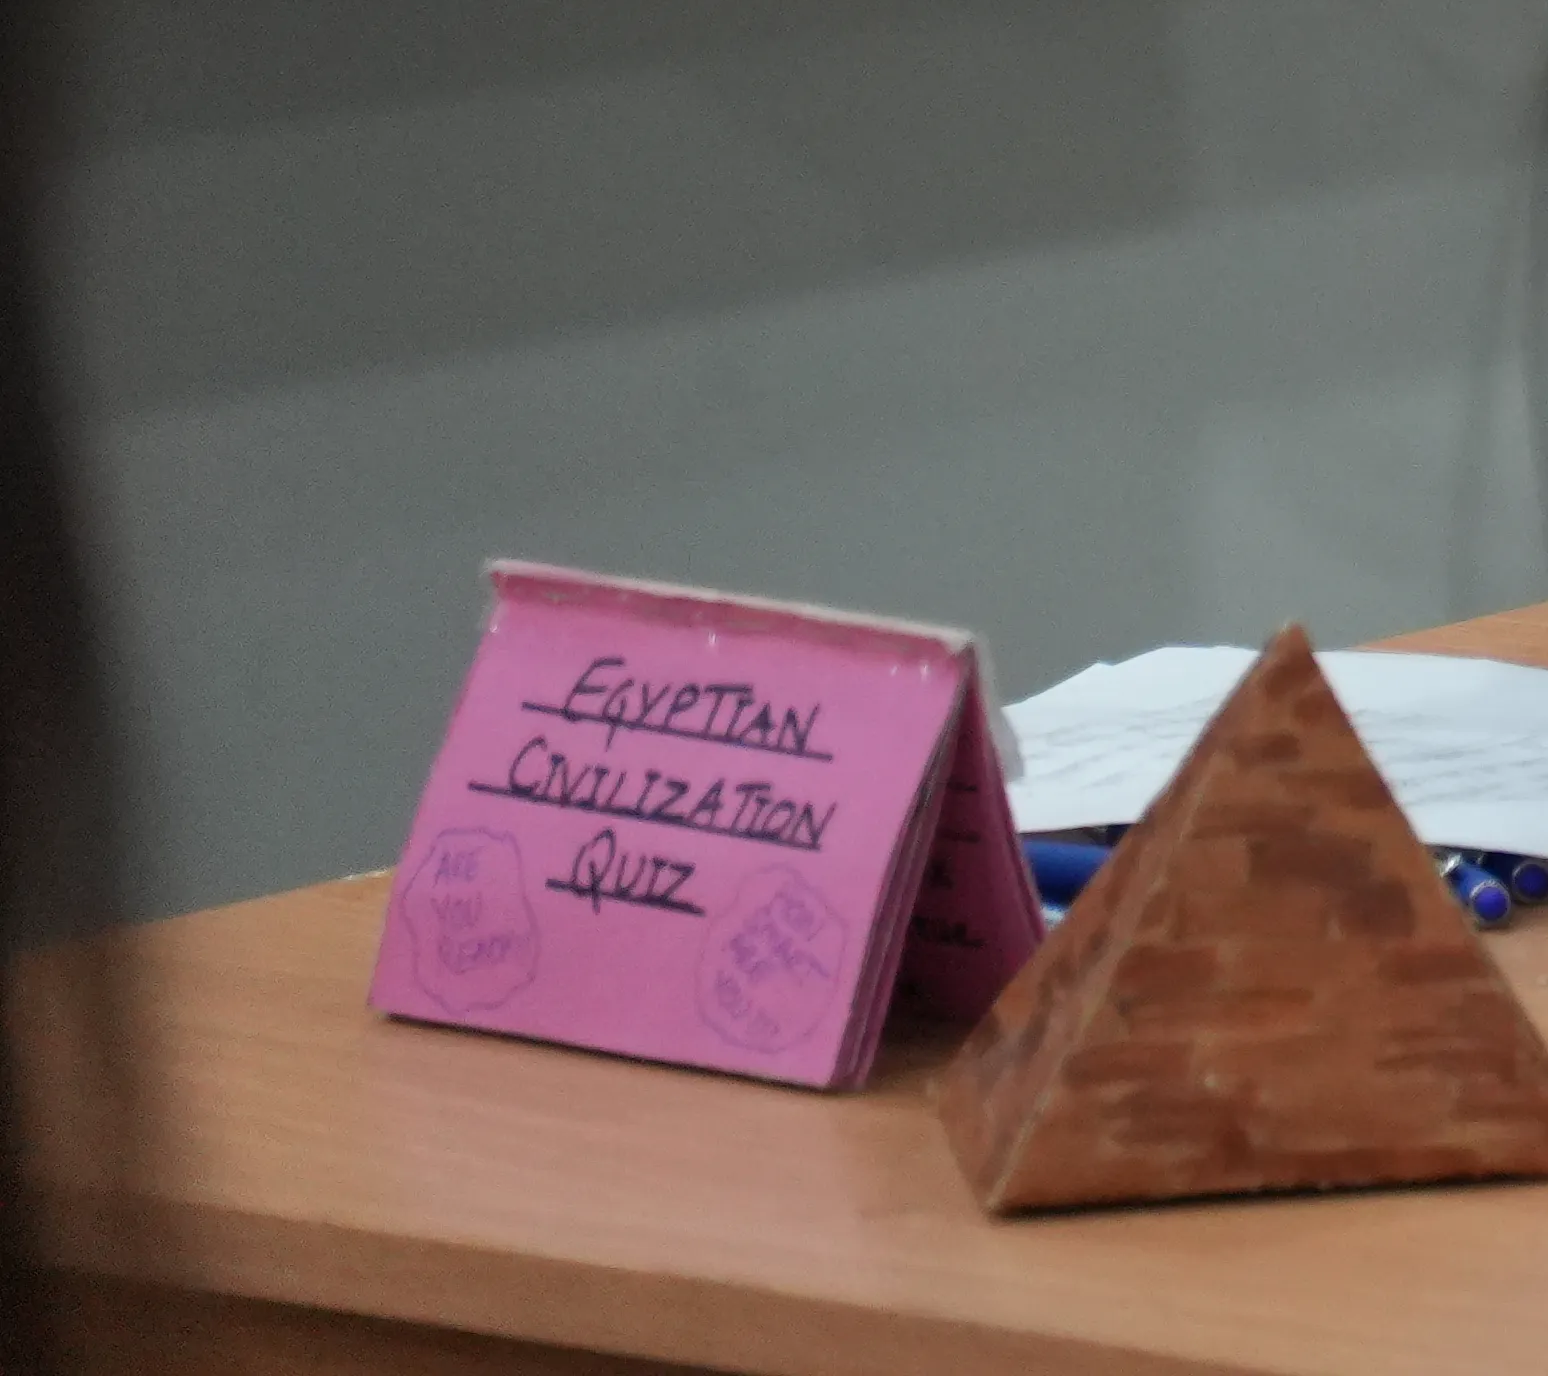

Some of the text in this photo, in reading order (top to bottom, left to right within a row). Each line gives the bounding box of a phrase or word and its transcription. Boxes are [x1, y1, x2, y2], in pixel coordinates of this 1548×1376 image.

[562, 656, 822, 753] EGYPTIAN
[508, 734, 838, 850] CIVILIZATION
[570, 827, 697, 915] QUIZ
